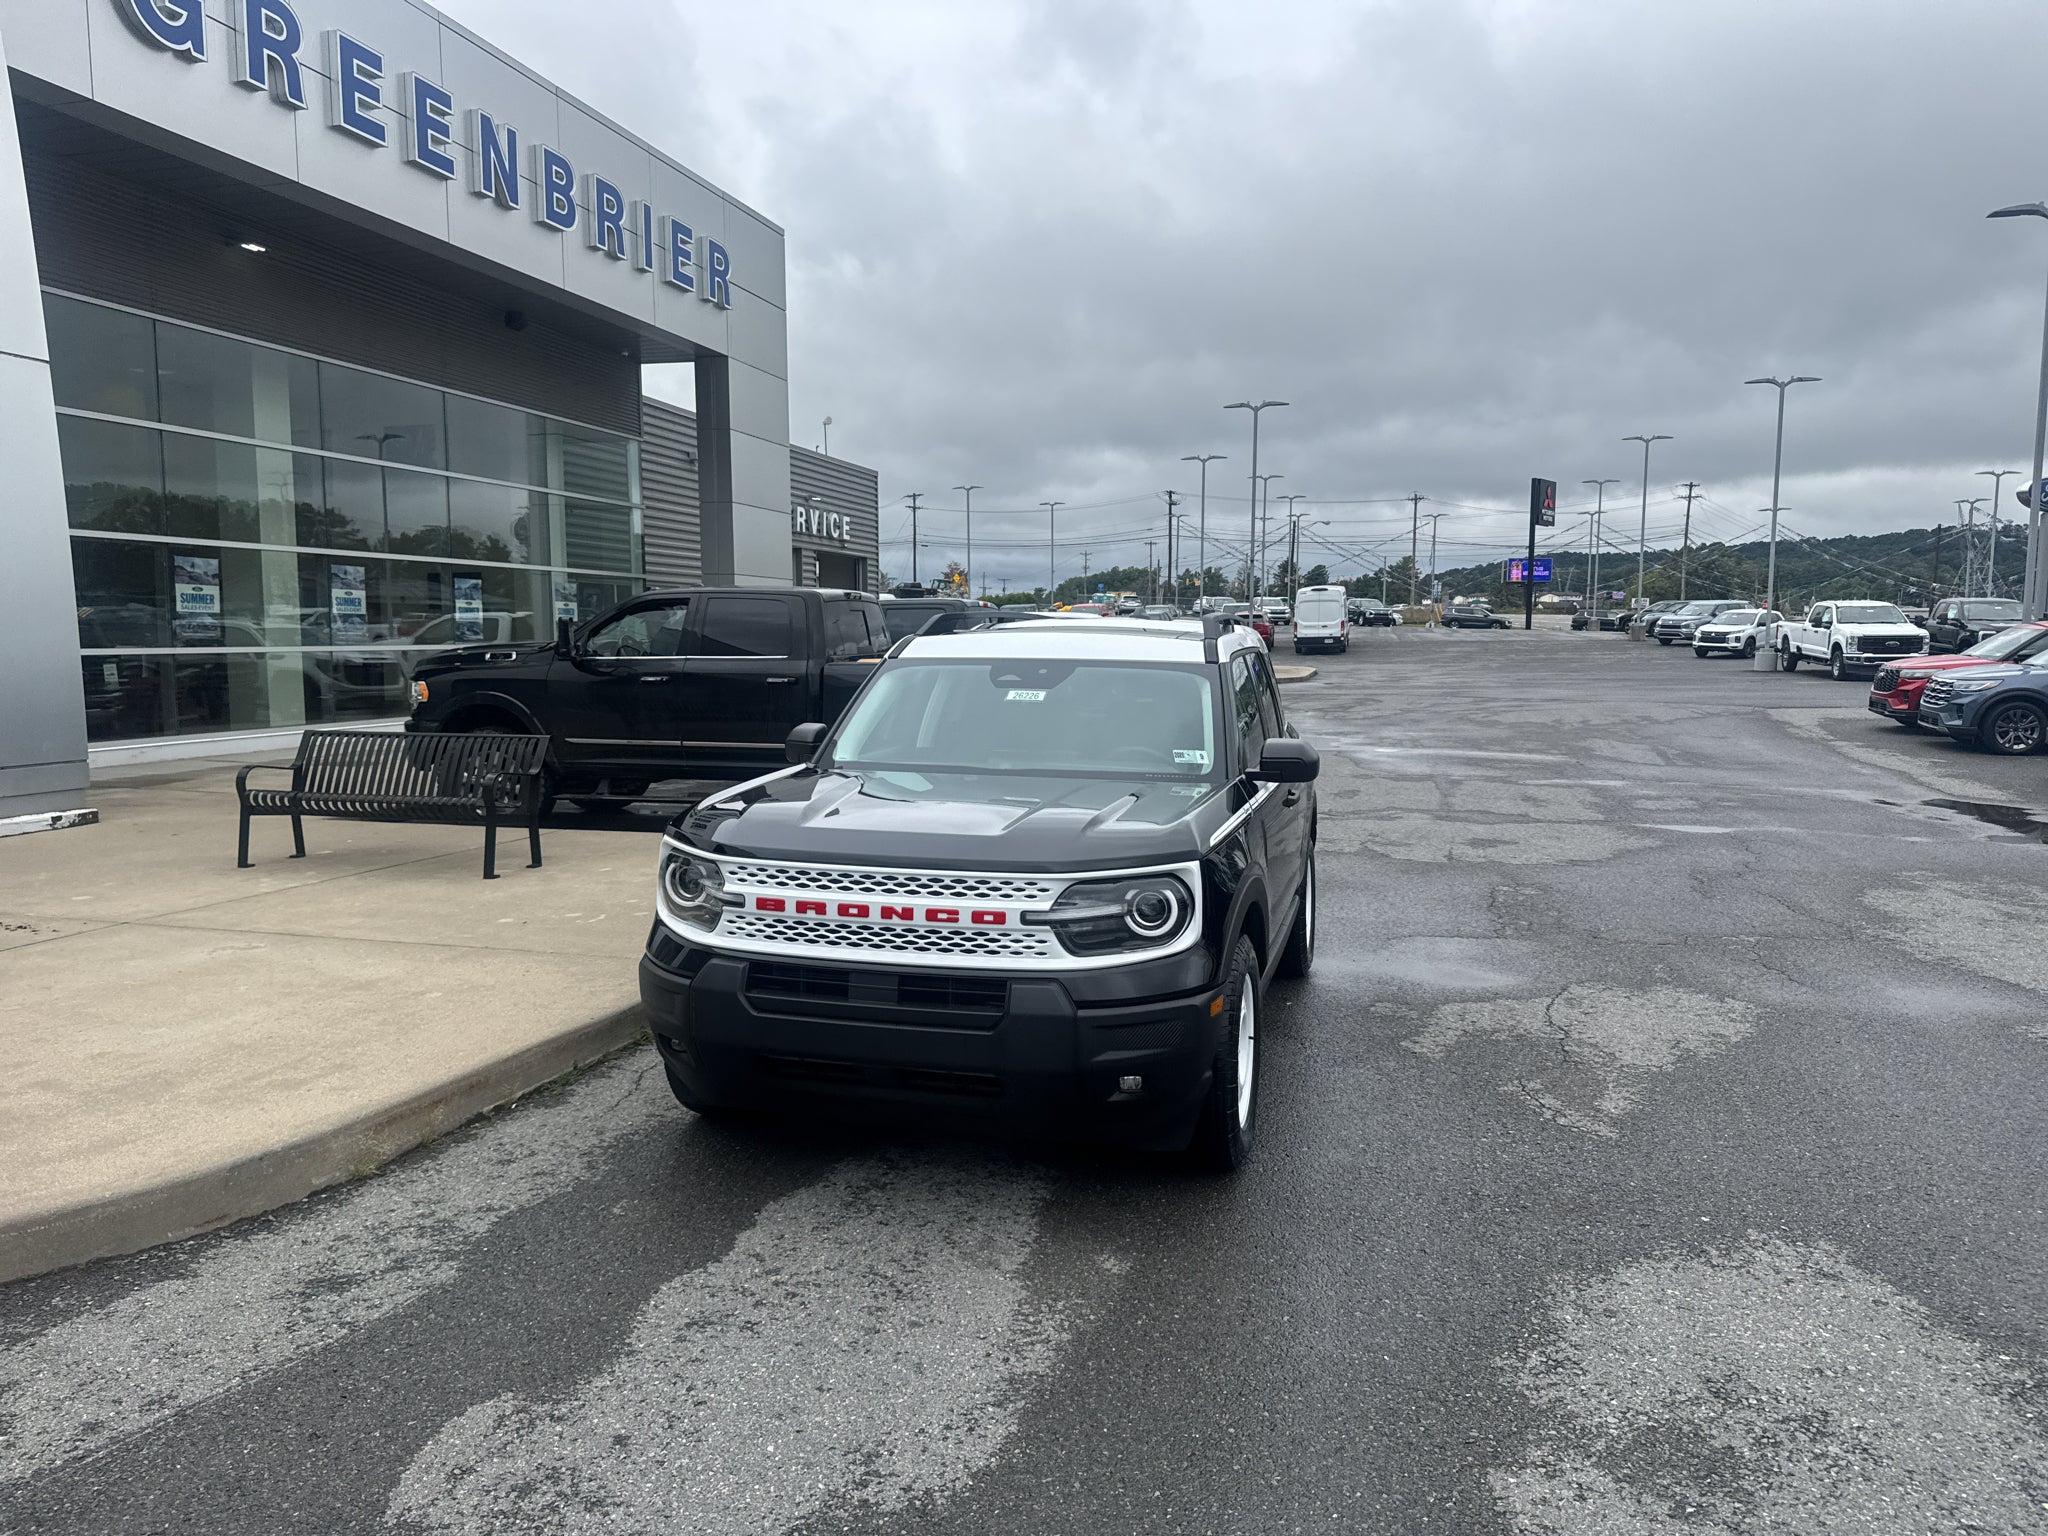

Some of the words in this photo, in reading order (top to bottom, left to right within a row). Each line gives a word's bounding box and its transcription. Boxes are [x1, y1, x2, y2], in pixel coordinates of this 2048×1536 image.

[180, 593, 215, 604] SUMMER
[1012, 691, 1040, 699] 26226
[755, 896, 1006, 925] BRONCO
